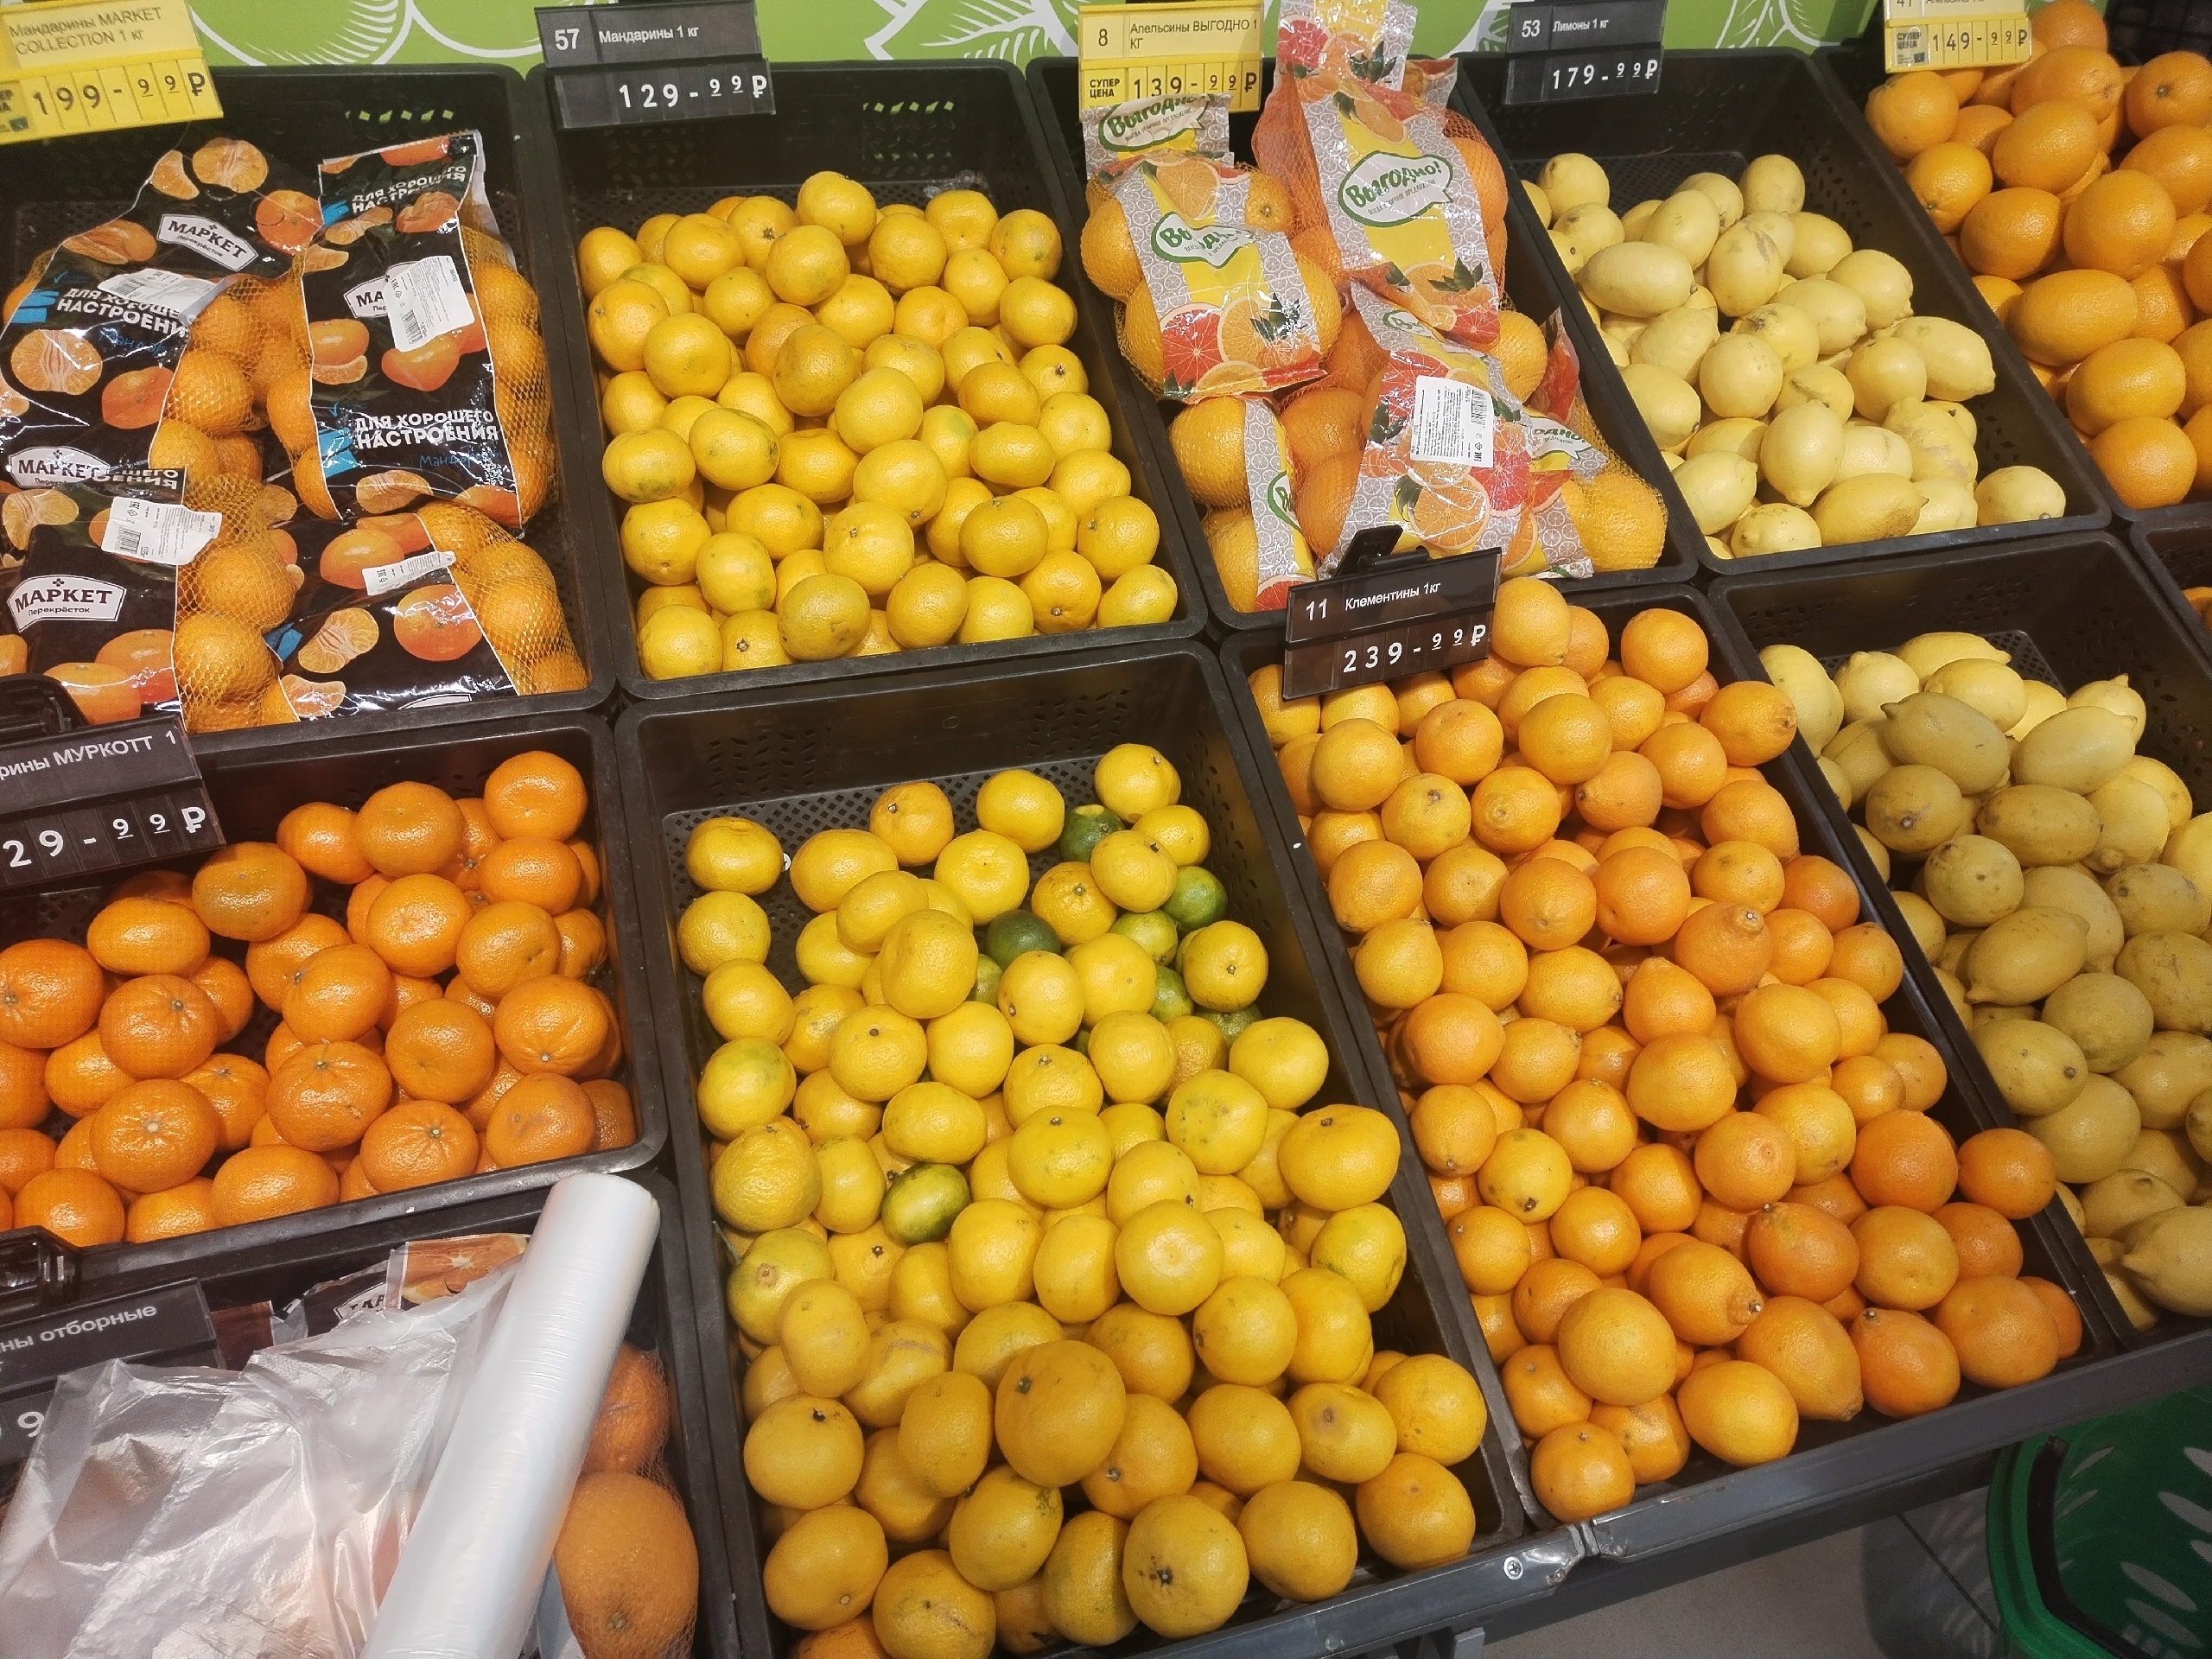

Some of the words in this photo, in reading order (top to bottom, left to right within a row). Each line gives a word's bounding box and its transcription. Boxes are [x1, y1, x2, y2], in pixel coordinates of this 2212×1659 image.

[9, 15, 97, 37] Мандарины
[99, 6, 162, 27] MARKET
[1130, 22, 1191, 35] Апельсины
[1192, 19, 1250, 33] ВЫГОДНО
[1253, 18, 1258, 29] 1
[1521, 19, 1541, 38] 53
[1552, 21, 1591, 33] Лимоны
[1592, 18, 1598, 29] 1
[1599, 19, 1610, 29] кг
[15, 30, 116, 55] COLLECTION
[118, 30, 127, 41] 1
[131, 29, 145, 41] кг
[554, 28, 581, 51] 57
[598, 28, 674, 44] Мандарины
[677, 25, 684, 38] 1
[687, 25, 700, 37] кг
[1097, 28, 1109, 48] 8
[1897, 41, 1918, 50] ЦЕНА
[1089, 79, 1121, 89] СУПЕР
[1089, 89, 1116, 99] ЦЕНА
[352, 188, 385, 202] ДЛЯ
[167, 220, 248, 258] МАРКЕТ
[63, 288, 103, 301] ДЛЯ
[354, 416, 391, 431] ДЛЯ
[396, 410, 494, 426] ХОРОШЕГО
[357, 425, 499, 449] НАСТРОЕНИЯ
[15, 588, 112, 613] МАРКЕТ
[1306, 598, 1328, 621] 11
[1344, 588, 1421, 612] Клементины
[28, 606, 91, 617] Перекрёсток
[53, 735, 153, 766] МУРКОТТ
[165, 730, 176, 745] 1
[40, 1306, 157, 1342] отборные
